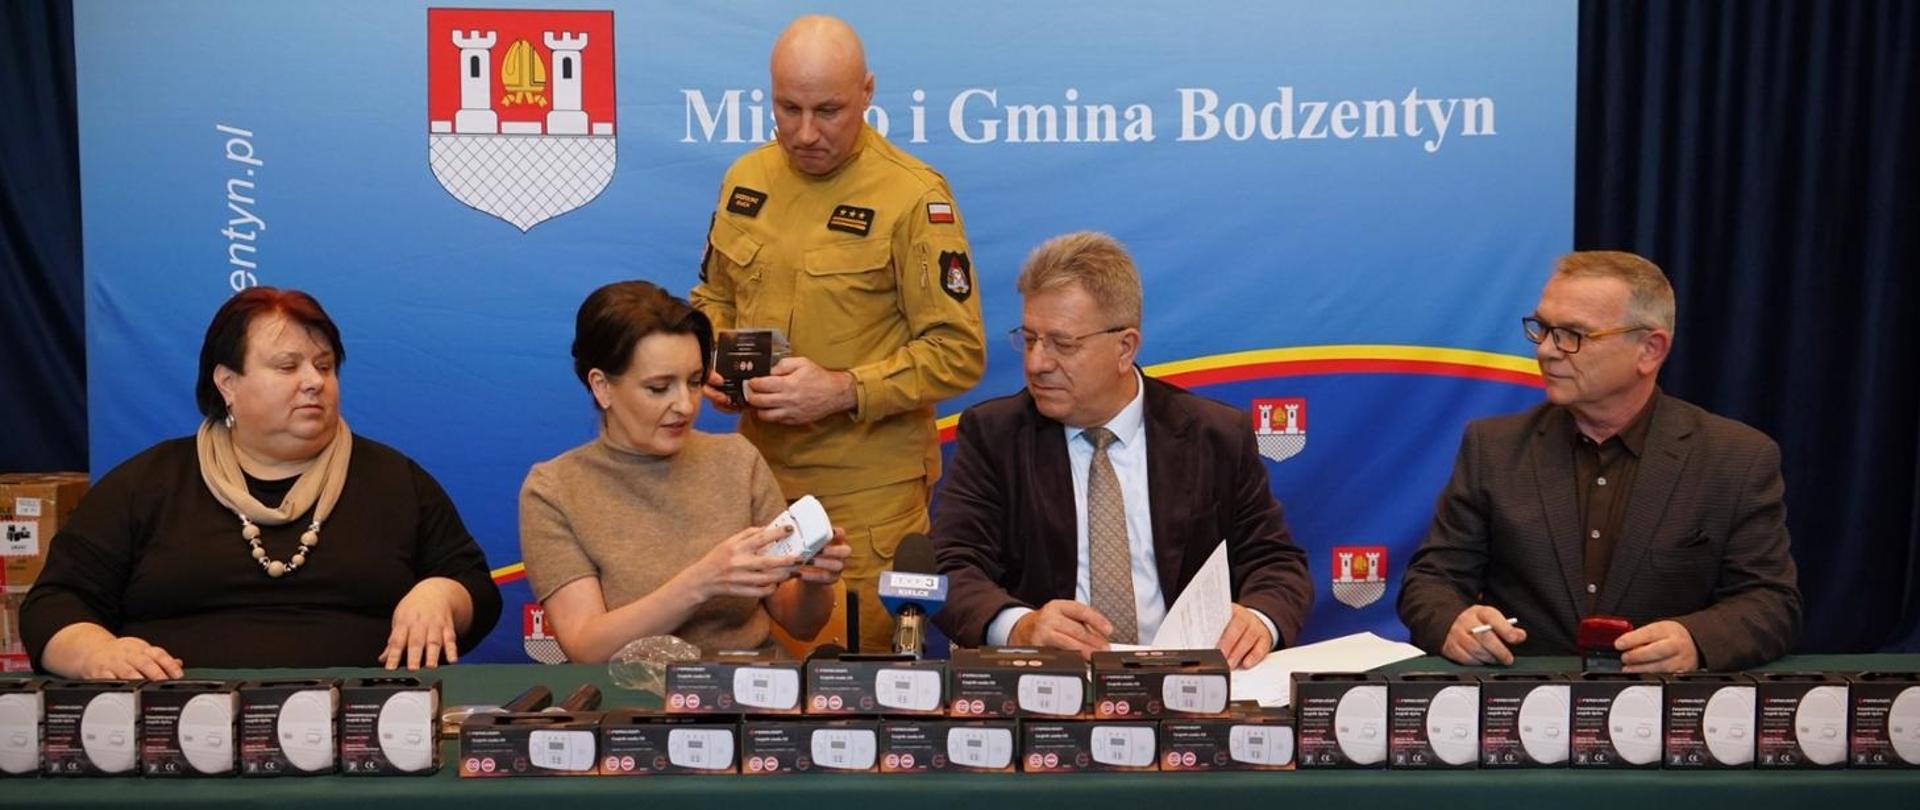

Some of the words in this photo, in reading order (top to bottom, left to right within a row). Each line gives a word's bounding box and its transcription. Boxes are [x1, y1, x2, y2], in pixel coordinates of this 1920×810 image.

[680, 89, 890, 144] Mio
[909, 89, 929, 143] i
[949, 88, 1156, 143] Gmina
[1176, 86, 1497, 152] Bodzentyn
[215, 124, 266, 293] entyn.pl
